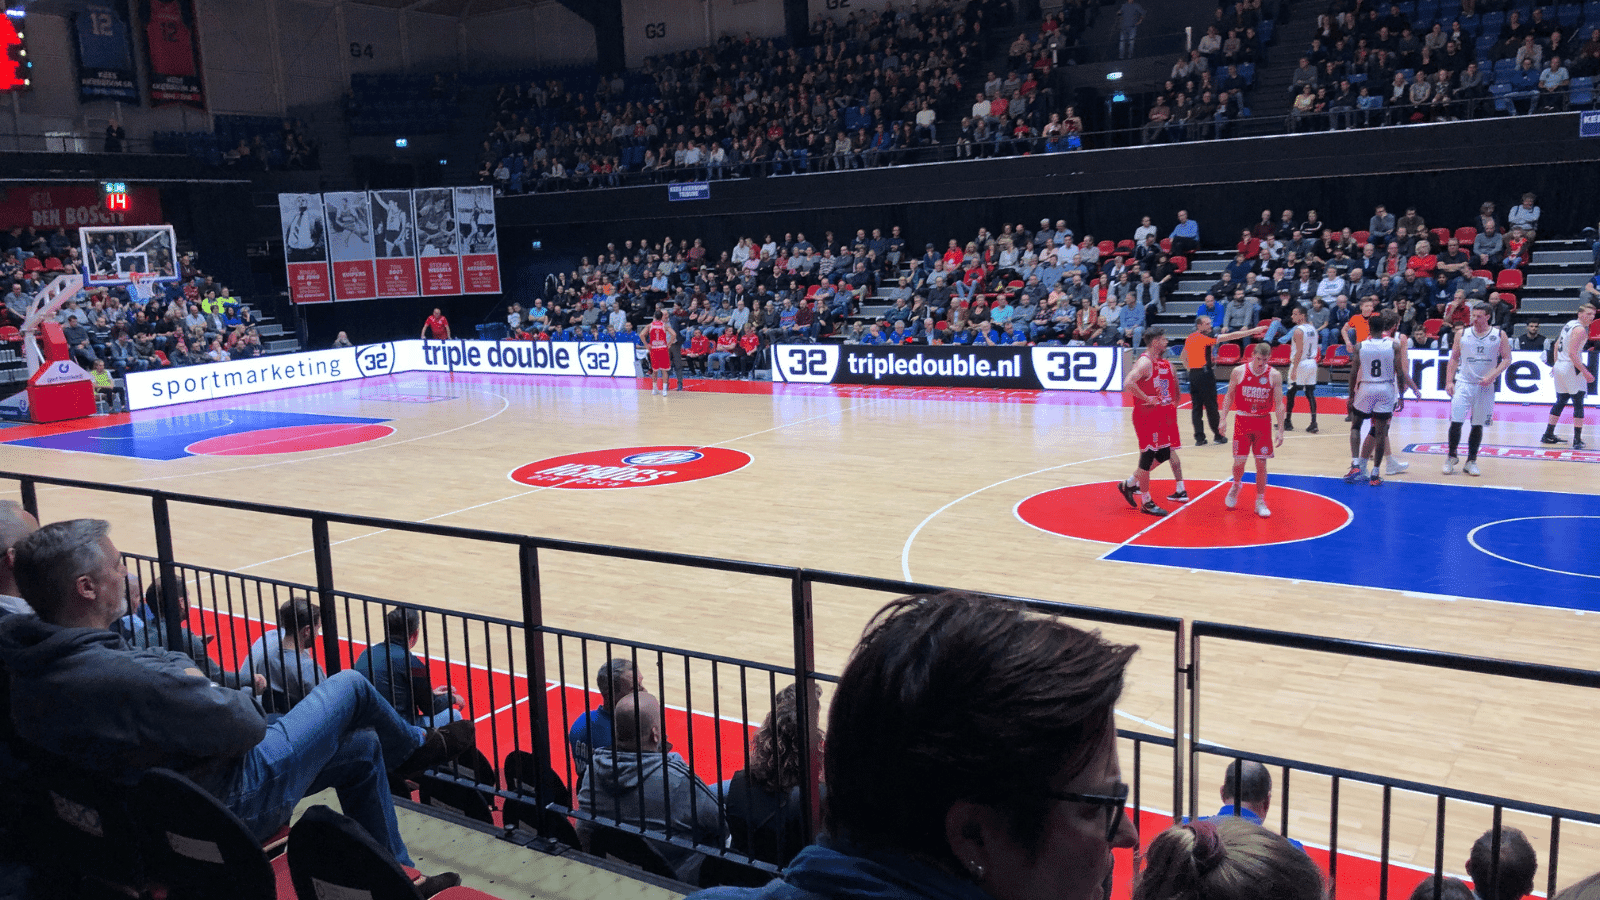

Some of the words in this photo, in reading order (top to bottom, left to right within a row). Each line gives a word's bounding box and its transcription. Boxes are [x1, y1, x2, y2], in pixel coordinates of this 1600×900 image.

[90, 12, 113, 36] 12
[645, 22, 666, 39] G3
[350, 42, 374, 59] G4
[111, 194, 125, 208] 14
[32, 209, 60, 225] DEN
[422, 340, 481, 372] triple
[486, 340, 569, 369] double
[587, 352, 610, 370] 32
[789, 349, 828, 375] 32
[847, 352, 1021, 379] tripledouble.nl
[1047, 351, 1098, 382] 32
[1371, 359, 1381, 377] 8
[151, 358, 341, 399] sportmarketing
[365, 352, 388, 371] 32
[1241, 385, 1271, 399] HEROES
